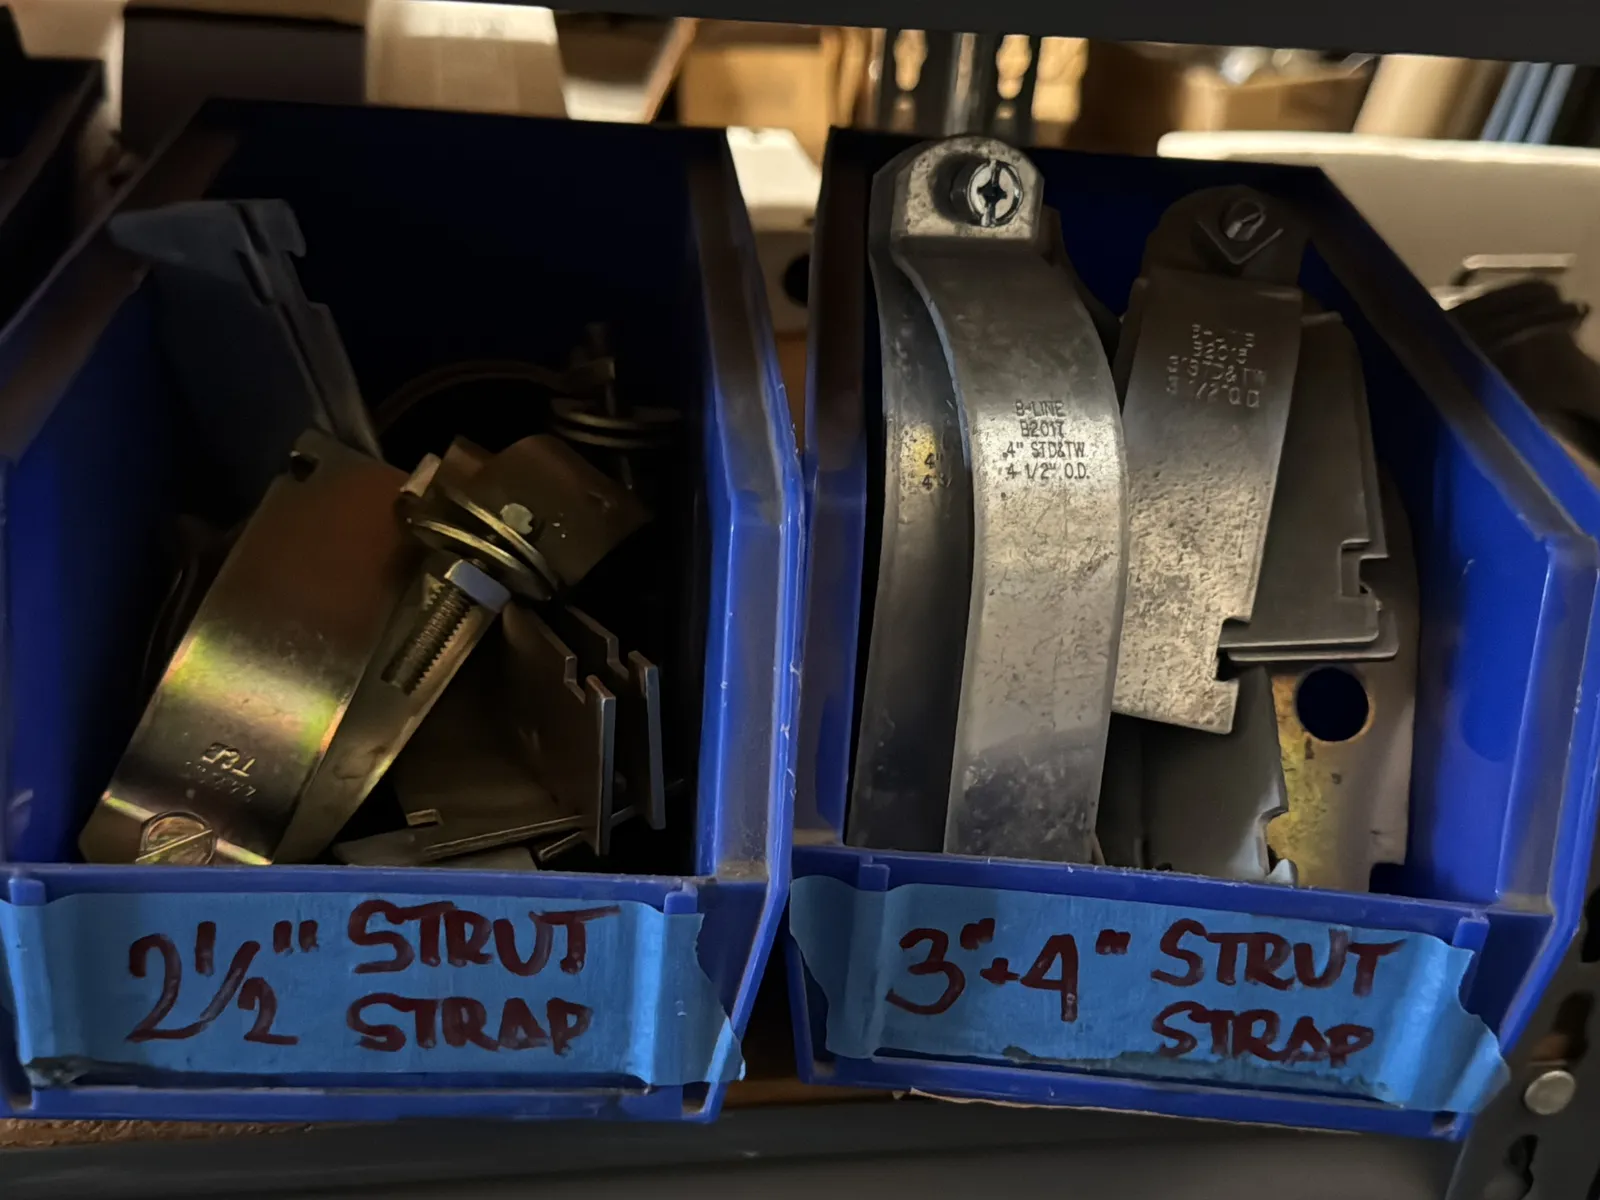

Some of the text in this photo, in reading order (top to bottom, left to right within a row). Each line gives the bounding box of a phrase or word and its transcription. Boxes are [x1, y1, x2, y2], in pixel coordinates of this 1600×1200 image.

[1014, 399, 1066, 417] B-LINE
[1030, 441, 1086, 459] STD&TW
[347, 900, 620, 977] STRUT
[1150, 918, 1407, 996] STRUT
[346, 996, 592, 1056] STRAP
[1150, 1000, 1374, 1067] STRAP
